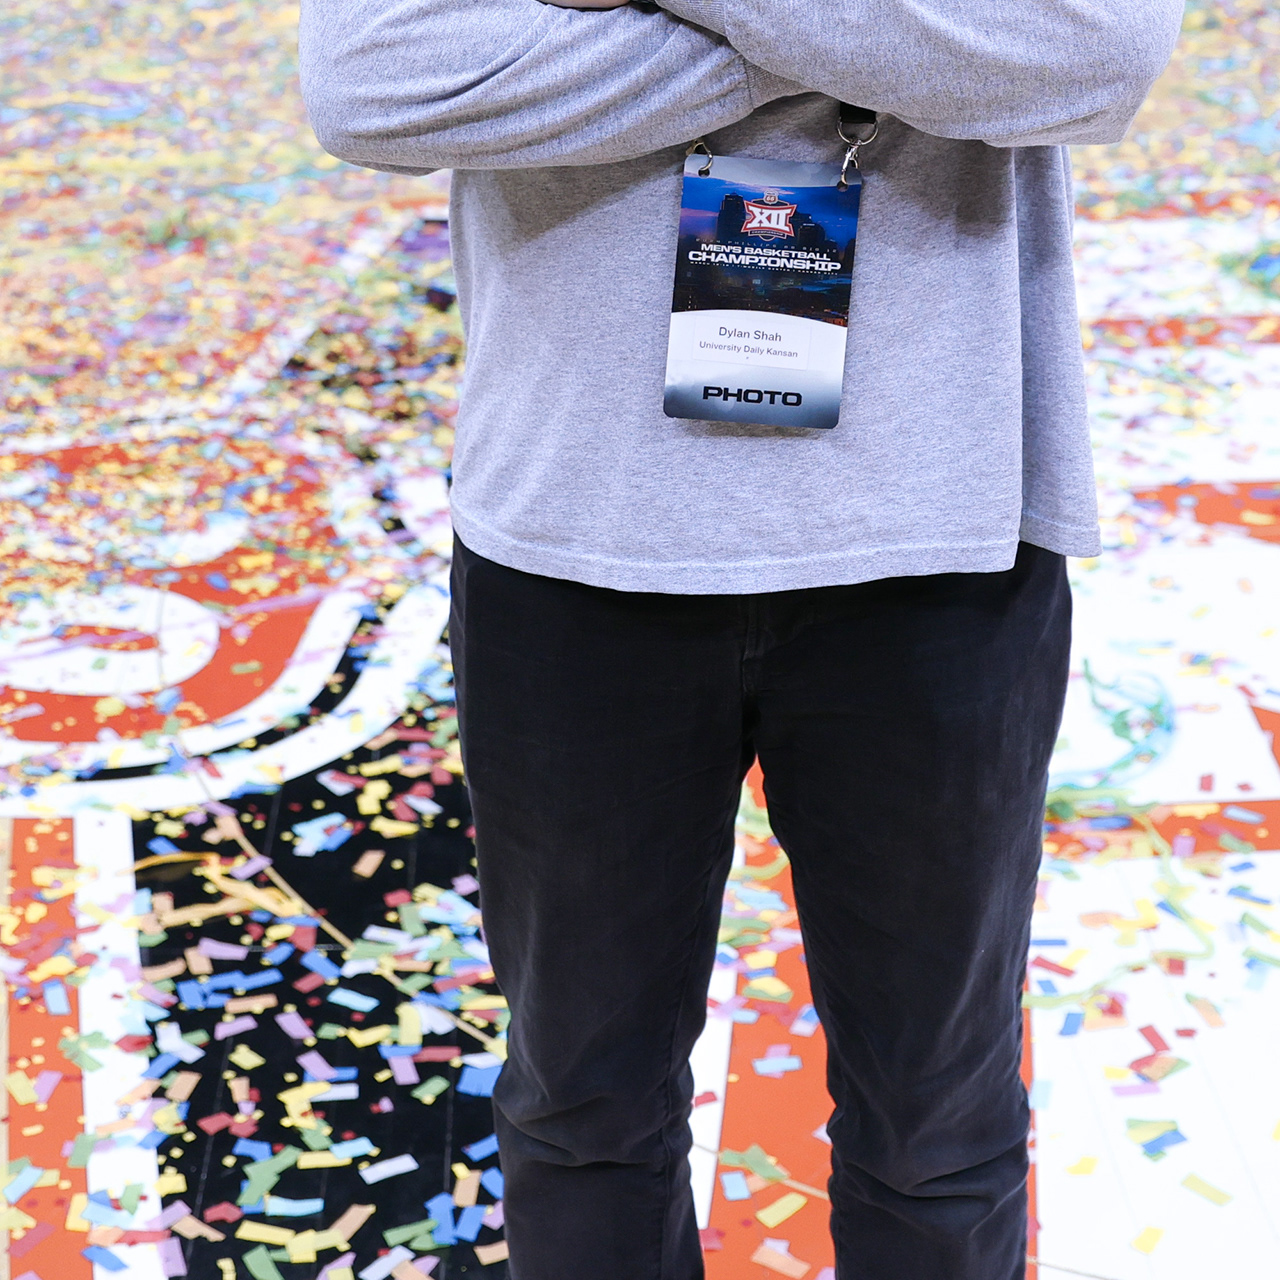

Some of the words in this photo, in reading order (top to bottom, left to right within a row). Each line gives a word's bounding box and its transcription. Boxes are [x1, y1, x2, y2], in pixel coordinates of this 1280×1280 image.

[745, 205, 793, 233] XII
[688, 250, 842, 272] CHAMPIONSHIP
[701, 243, 742, 254] MEN'S
[744, 246, 831, 261] BASKETBALL
[719, 326, 751, 339] Dylan
[753, 330, 782, 342] Shah
[699, 341, 742, 353] University
[743, 345, 765, 356] Daily
[766, 348, 798, 358] Kansan
[702, 385, 803, 407] PHOTO
